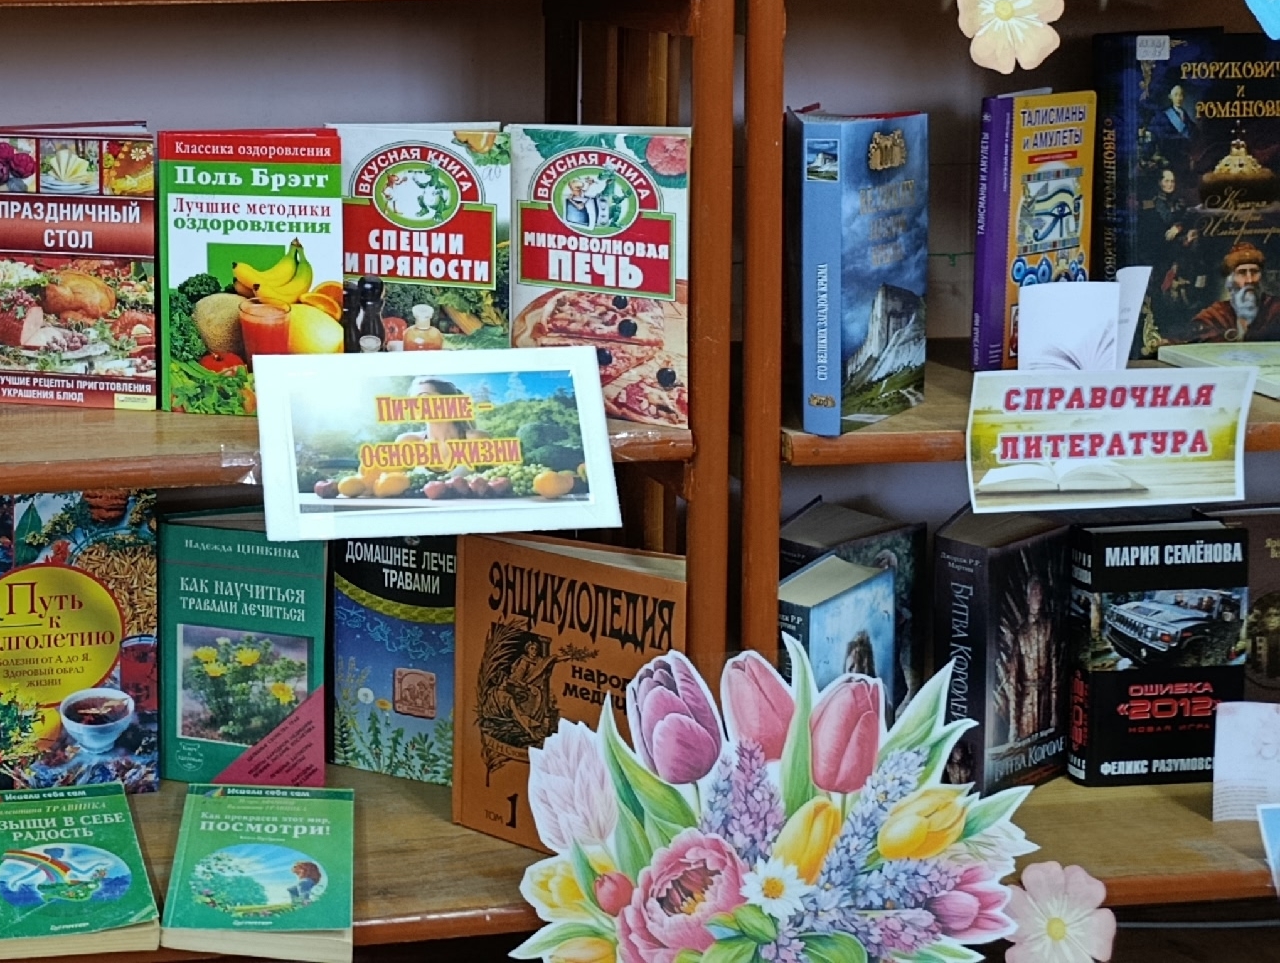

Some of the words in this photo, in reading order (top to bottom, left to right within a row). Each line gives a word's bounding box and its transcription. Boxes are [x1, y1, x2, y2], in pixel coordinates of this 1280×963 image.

[1021, 105, 1086, 128] ТАЛИСМАНЫ
[175, 141, 234, 155] Классика
[238, 145, 332, 158] оздоровления
[1032, 128, 1083, 150] АМУЛЕТЫ
[174, 165, 243, 186] Поль
[251, 167, 329, 192] Брэгг
[359, 147, 420, 194] ВКУСНАЯ
[173, 197, 241, 218] Лучшие
[246, 202, 332, 218] методики
[977, 181, 987, 236] ТАЛИСМАНЫ
[43, 228, 93, 249] СТОЛ
[173, 214, 332, 236] оздоровления
[368, 228, 465, 257] СПЕЦИИ
[523, 231, 669, 260] МИКРОВОЛНОВАЯ
[364, 253, 489, 283] ПРЯНОСТИ
[548, 249, 644, 289] ПЕЧЬ
[818, 264, 827, 293] КРЫМА
[817, 328, 827, 363] ВЕЛИКИХ
[76, 379, 152, 393] ПРИГОТОВЛЕНИЯ
[1004, 383, 1214, 412] СПРАВОЧНАЯ
[1000, 430, 1208, 461] ЛИТЕРАТУРА
[345, 541, 417, 569] ДОМАШНЕЕ
[1105, 546, 1159, 567] МАРИЯ
[1164, 540, 1243, 564] СЕМЁНОВА
[6, 582, 83, 618] Путь
[180, 596, 238, 615] ТРАВАМИ
[241, 603, 306, 622] ЛЕЧИТЬСЯ
[488, 561, 676, 654] ЭНЦИКЛОПЕДИЯ
[950, 580, 973, 639] БИТВА
[1128, 682, 1213, 697] ОШИБКА
[1128, 725, 1172, 733] НОВАЯ
[1179, 724, 1210, 732] ИГРА
[1100, 760, 1148, 776] ФЕЛИКС
[227, 788, 263, 796] Исцели
[80, 812, 125, 825] СЕБЕ
[224, 813, 278, 823] прекрасен
[12, 827, 93, 841] РАДОСТЬ
